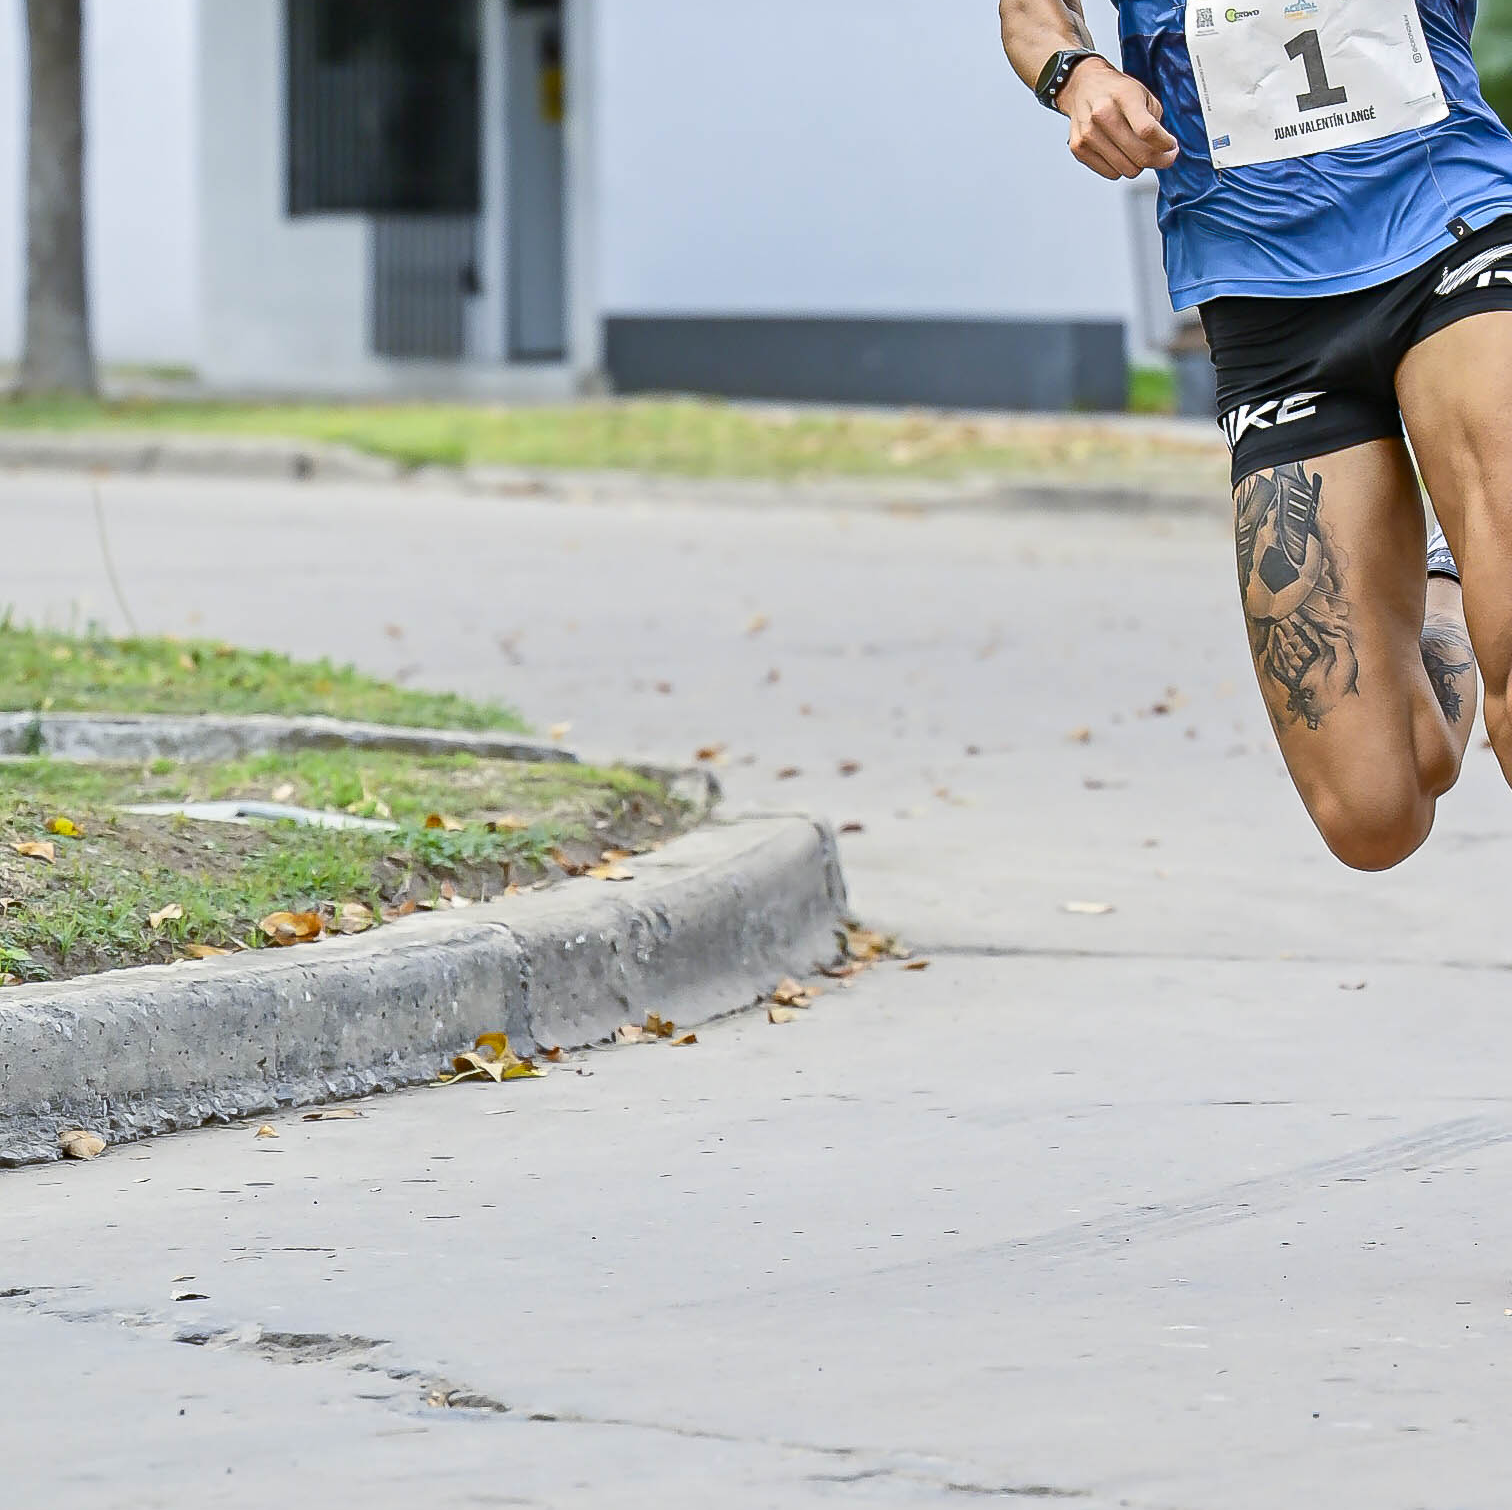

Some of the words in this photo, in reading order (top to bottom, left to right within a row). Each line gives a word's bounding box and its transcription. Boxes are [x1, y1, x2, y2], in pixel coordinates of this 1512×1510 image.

[1284, 29, 1348, 113] 1
[1274, 124, 1298, 141] JUAN
[1298, 112, 1345, 135] VALENTÍN
[1344, 104, 1377, 124] LANGÉ
